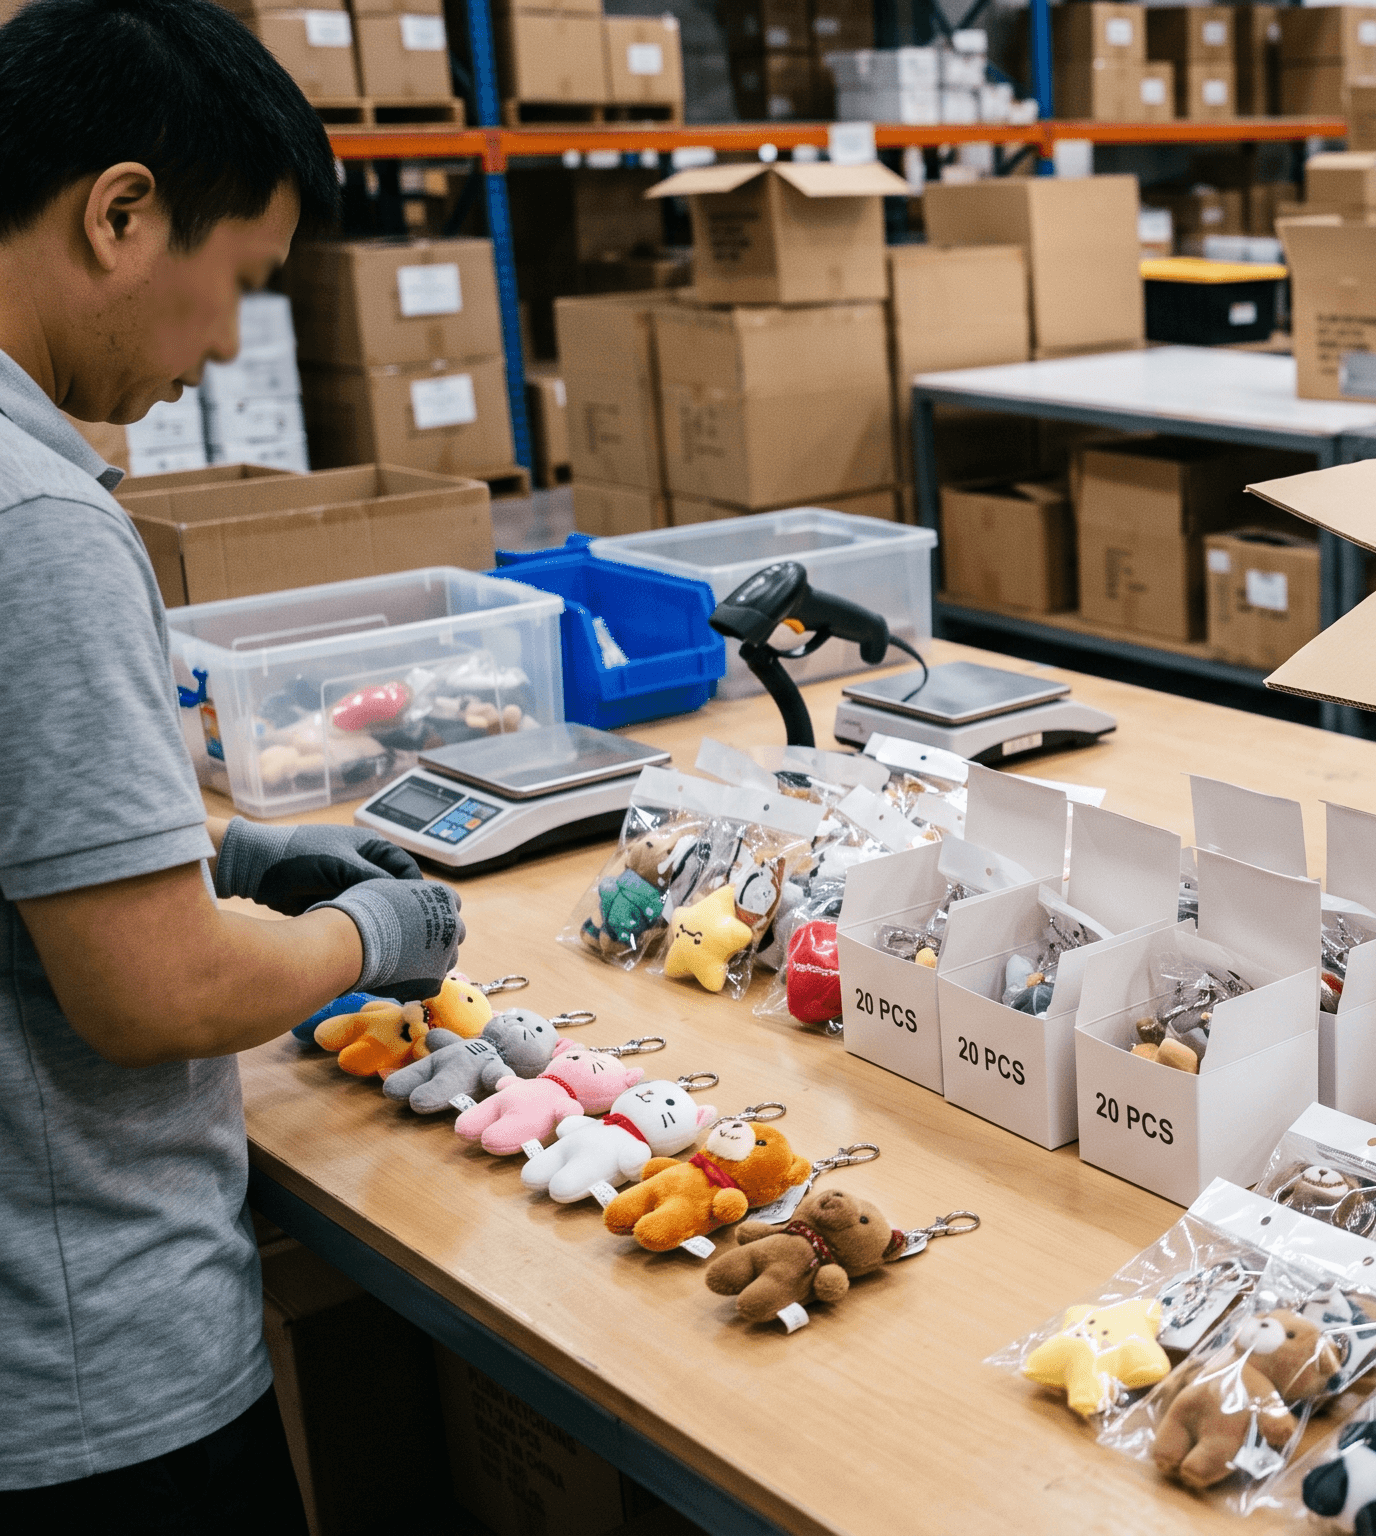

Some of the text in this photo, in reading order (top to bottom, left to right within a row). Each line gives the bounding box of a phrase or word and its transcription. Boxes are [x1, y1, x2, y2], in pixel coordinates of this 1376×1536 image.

[855, 988, 917, 1033] 20 PCS
[958, 1036, 1026, 1085] 20 PCS
[1095, 1092, 1174, 1145] 20 PCS
